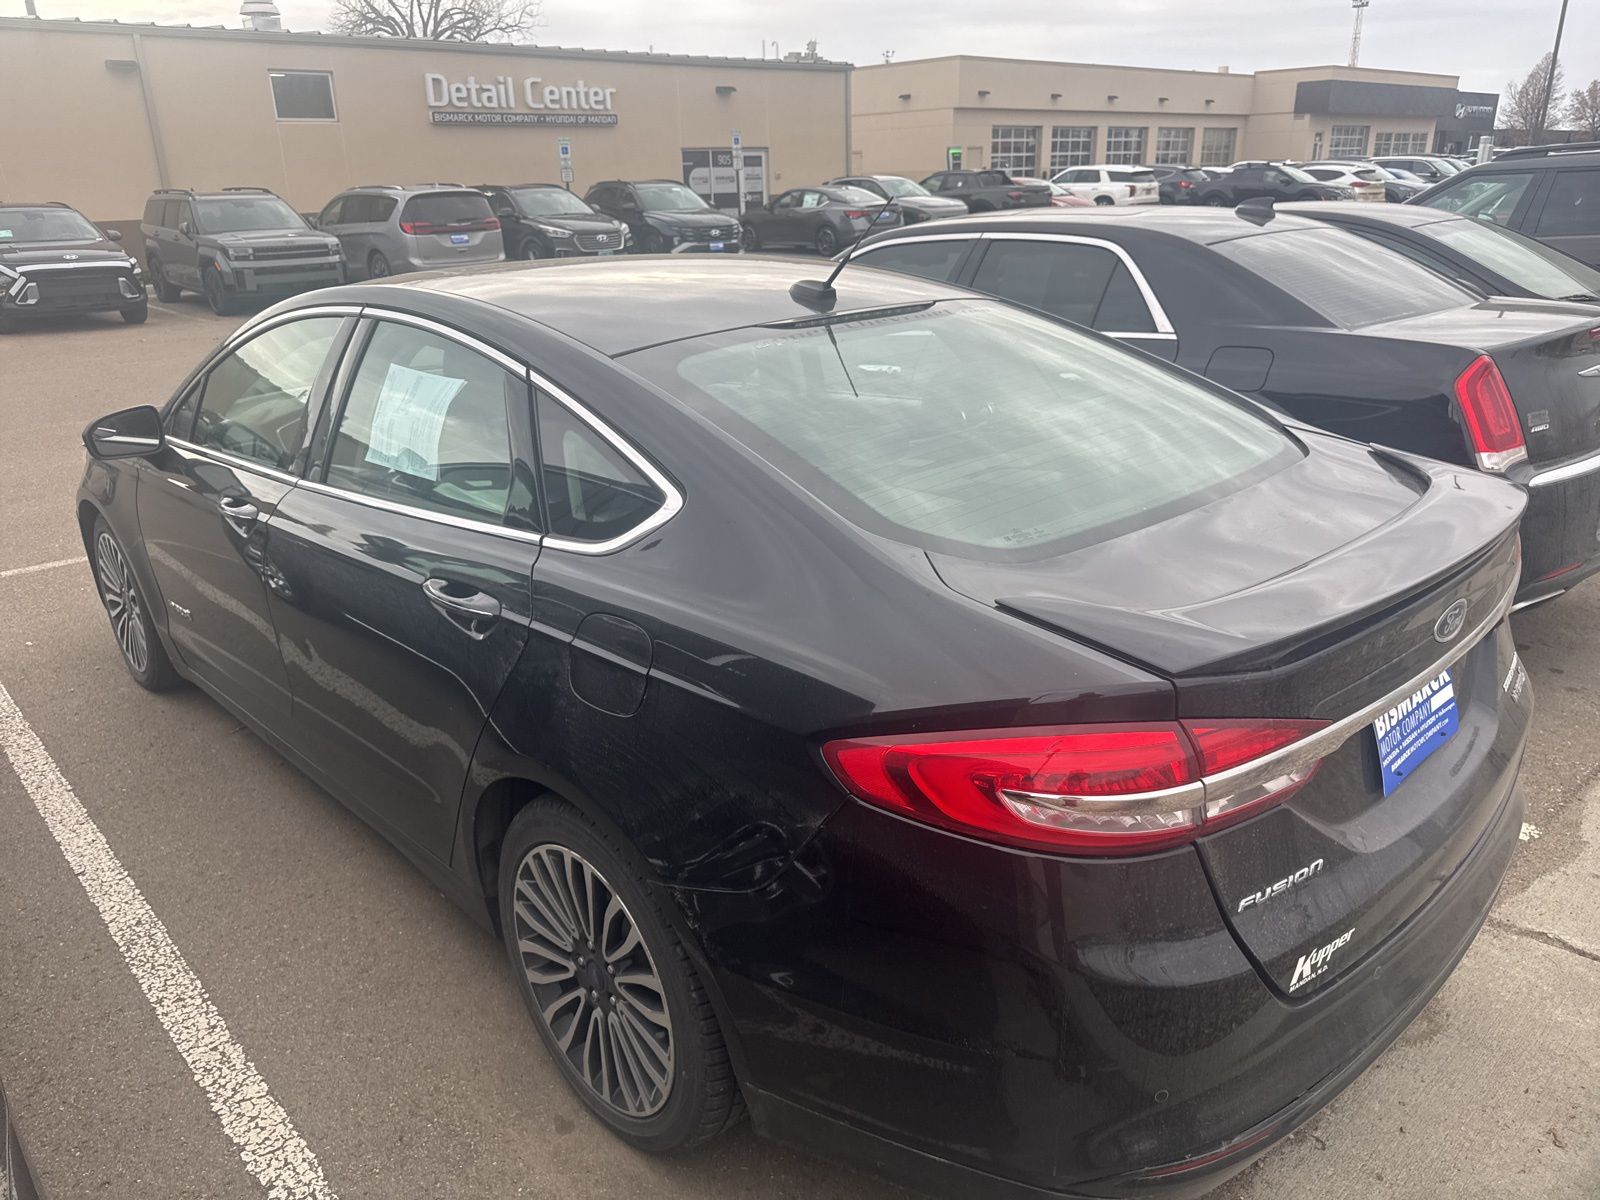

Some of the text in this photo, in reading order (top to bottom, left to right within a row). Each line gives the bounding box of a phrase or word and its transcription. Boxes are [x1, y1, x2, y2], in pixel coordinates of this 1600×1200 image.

[424, 72, 617, 110] Detail Center
[434, 113, 474, 123] BISMARCK
[475, 114, 502, 123] MOTOR
[503, 115, 538, 124] COMPANY
[545, 115, 576, 124] HYUNDAI
[577, 116, 587, 124] OF
[1380, 699, 1432, 758] MOTOR COMPANY
[1238, 858, 1324, 913] FUSION
[1289, 927, 1356, 987] Kupper
